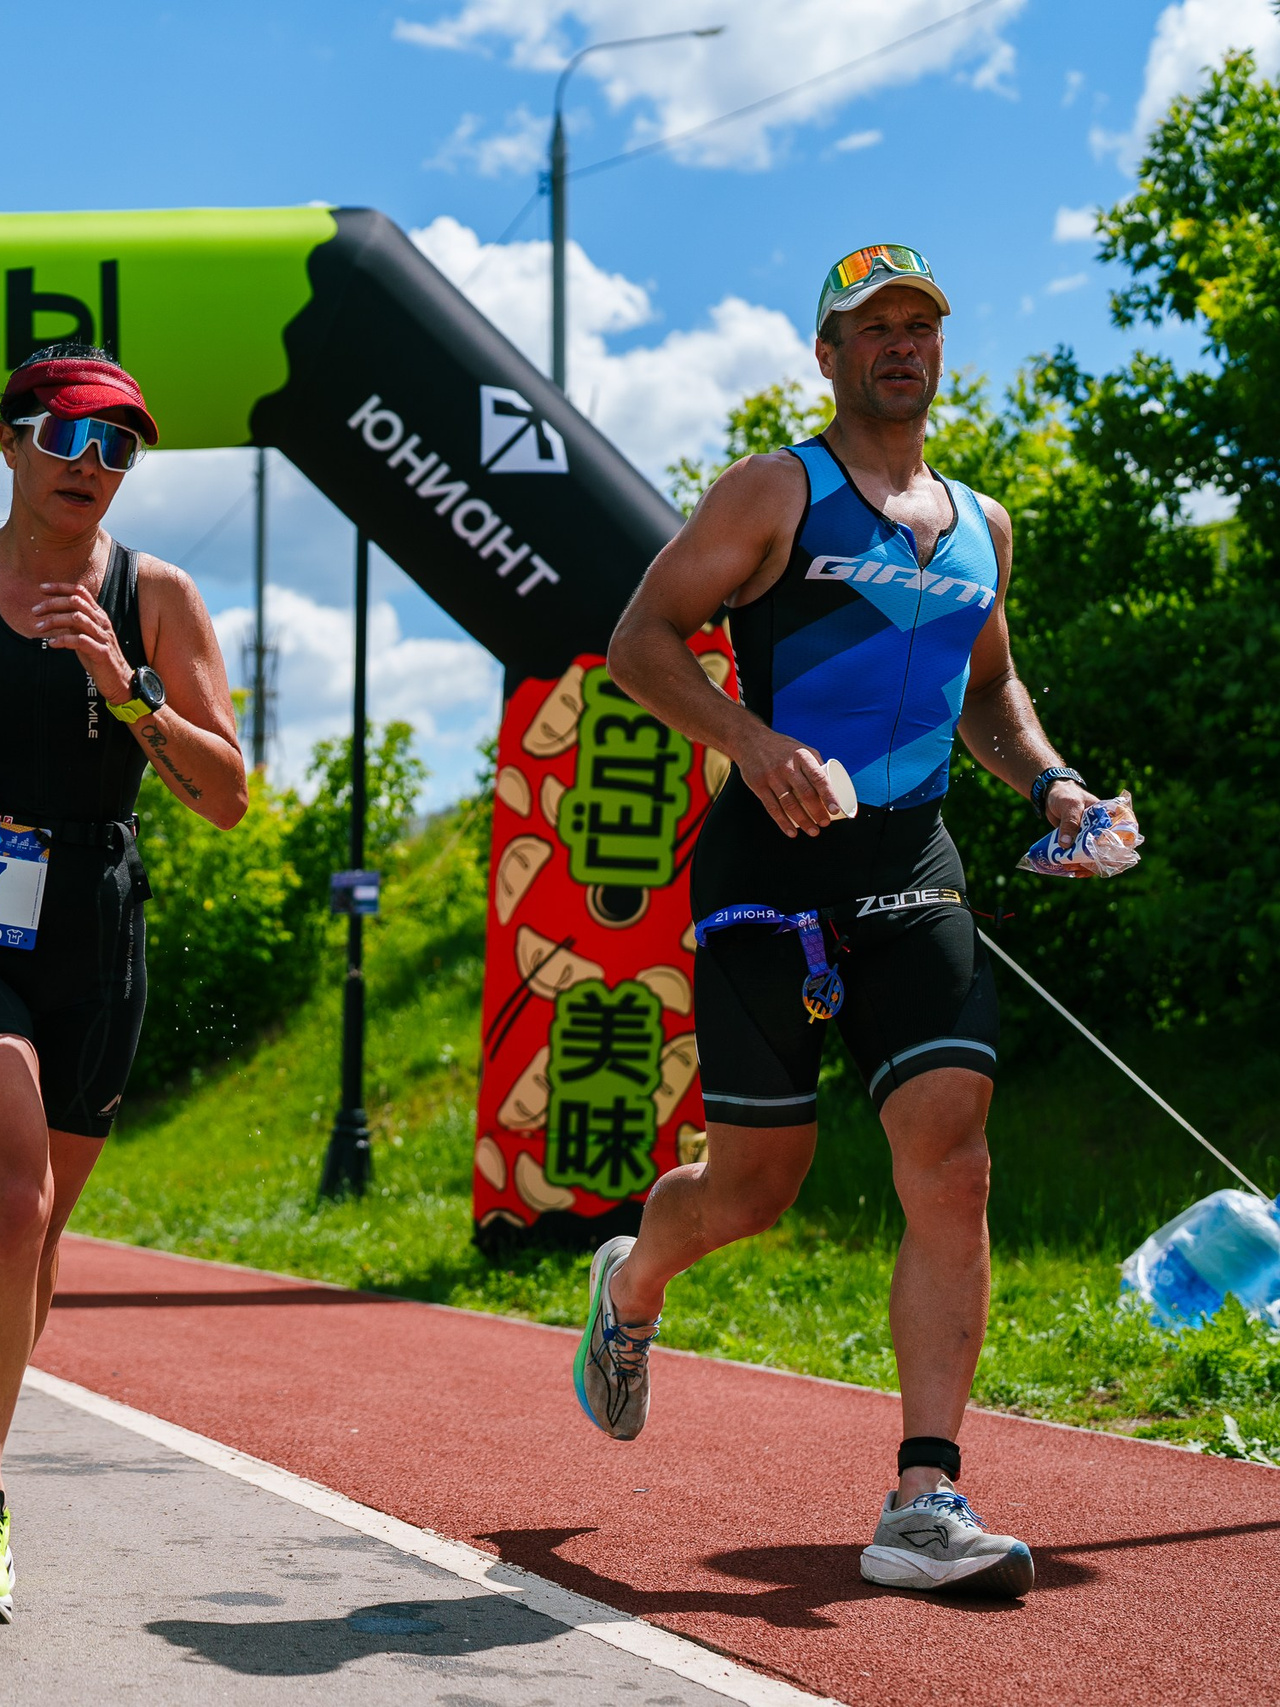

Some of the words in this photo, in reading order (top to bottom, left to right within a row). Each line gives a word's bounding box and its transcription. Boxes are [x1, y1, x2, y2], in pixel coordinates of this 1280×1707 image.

[805, 555, 996, 610] GIANT
[87, 701, 99, 739] MILE
[572, 681, 679, 872] ГЁДЗ
[715, 911, 728, 923] 21
[558, 991, 662, 1189] 美味
